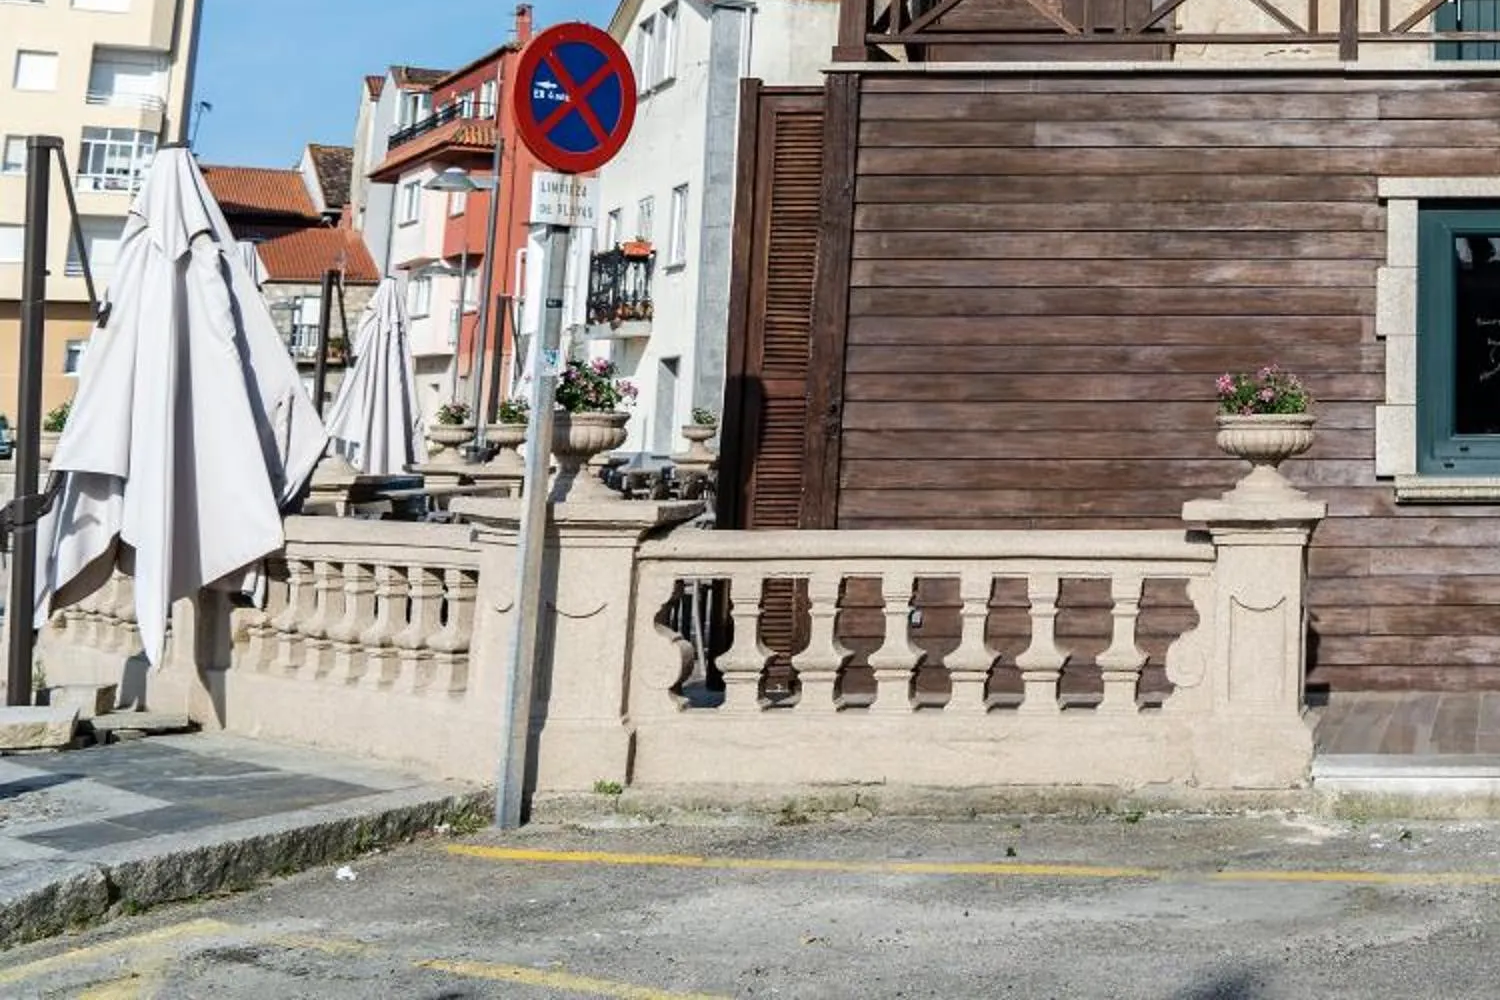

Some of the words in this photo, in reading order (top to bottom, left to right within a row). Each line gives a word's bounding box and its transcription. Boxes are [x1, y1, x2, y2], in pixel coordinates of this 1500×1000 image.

[540, 180, 587, 198] LIMPIEZA
[539, 203, 552, 215] DE
[557, 203, 593, 219] PLAYAS
